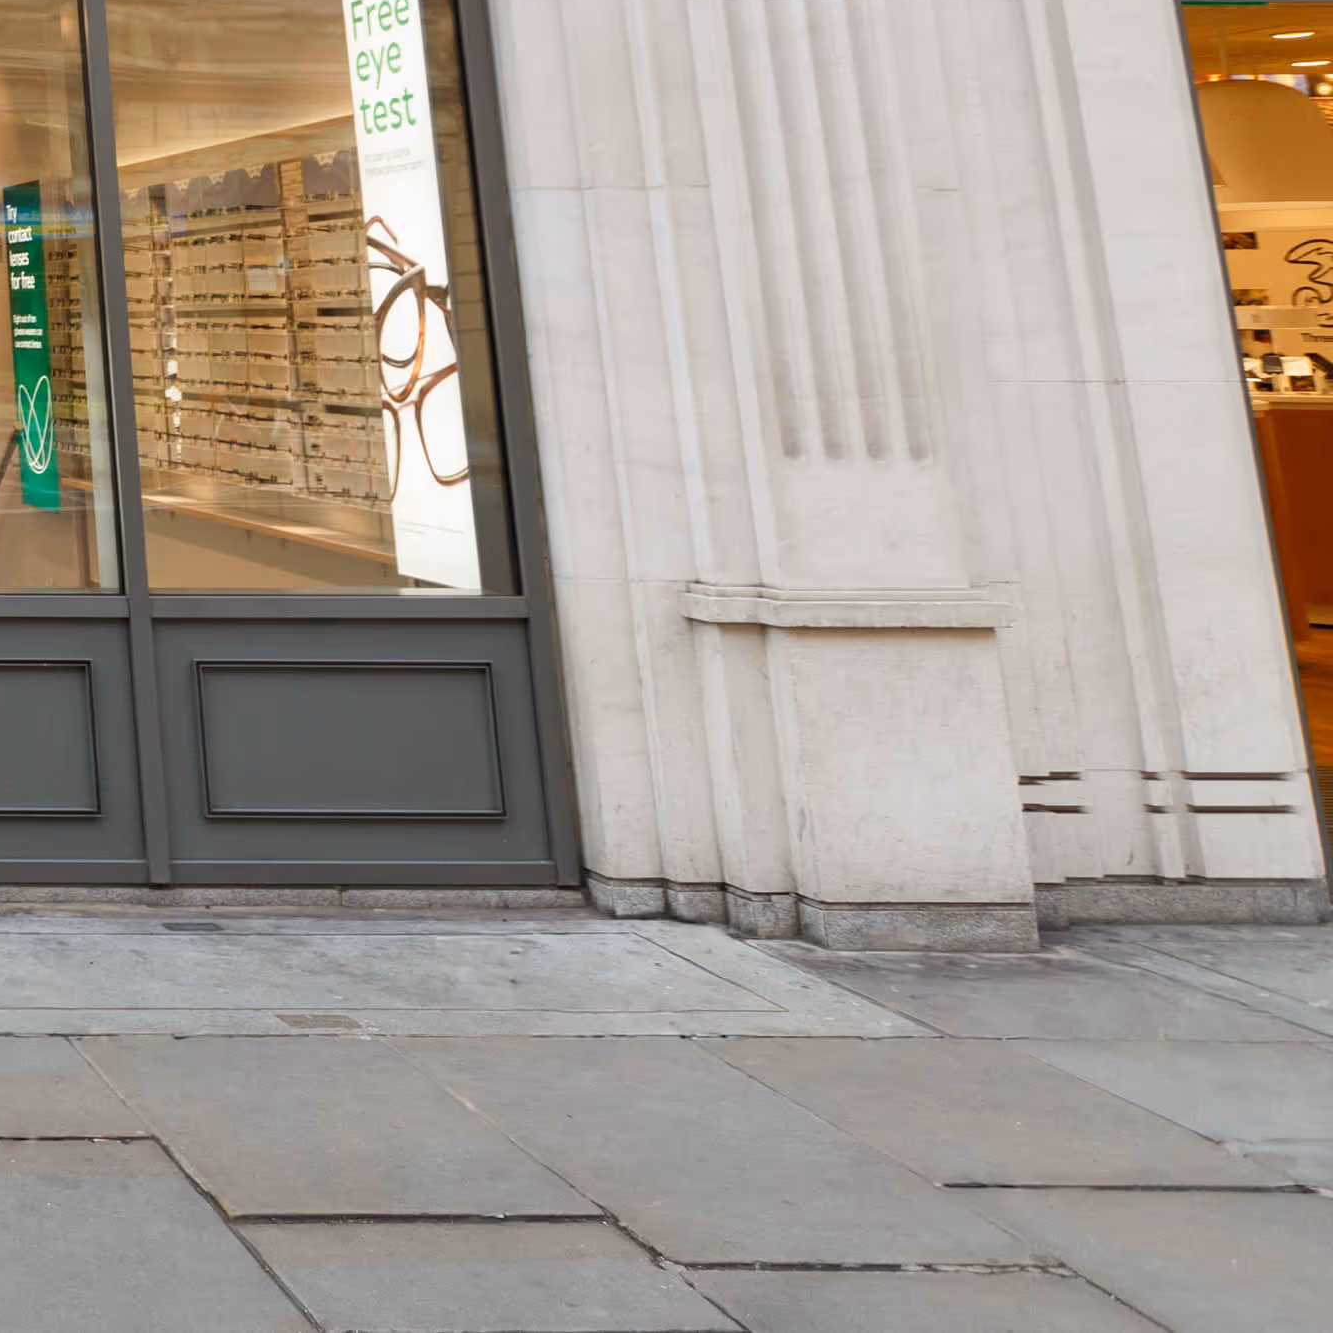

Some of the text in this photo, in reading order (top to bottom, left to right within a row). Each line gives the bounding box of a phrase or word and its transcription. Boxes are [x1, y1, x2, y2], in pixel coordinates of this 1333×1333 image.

[356, 42, 402, 90] eye
[359, 87, 417, 135] test
[6, 205, 17, 223] Try
[8, 226, 32, 243] contact
[9, 251, 29, 266] lenses
[10, 271, 35, 290] for free
